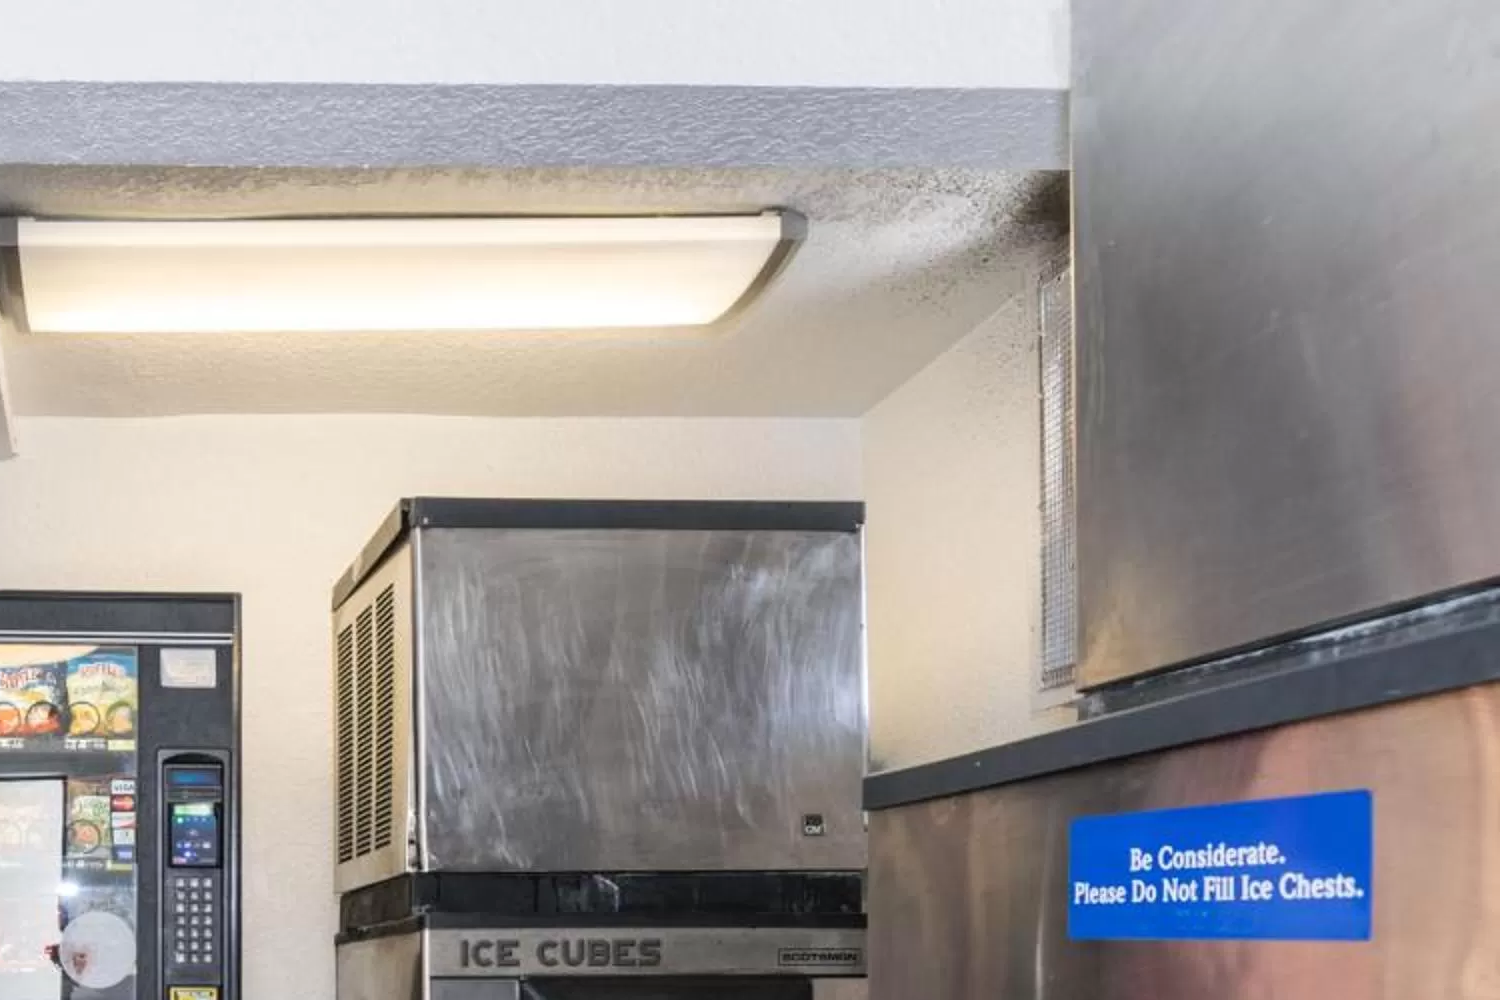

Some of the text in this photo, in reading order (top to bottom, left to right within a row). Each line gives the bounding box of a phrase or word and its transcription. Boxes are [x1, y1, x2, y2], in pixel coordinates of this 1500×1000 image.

[1129, 841, 1286, 871] Be Considerate.
[1074, 872, 1363, 904] Please Do Not Fill Ice Chests.
[460, 939, 662, 968] ICE CUBES
